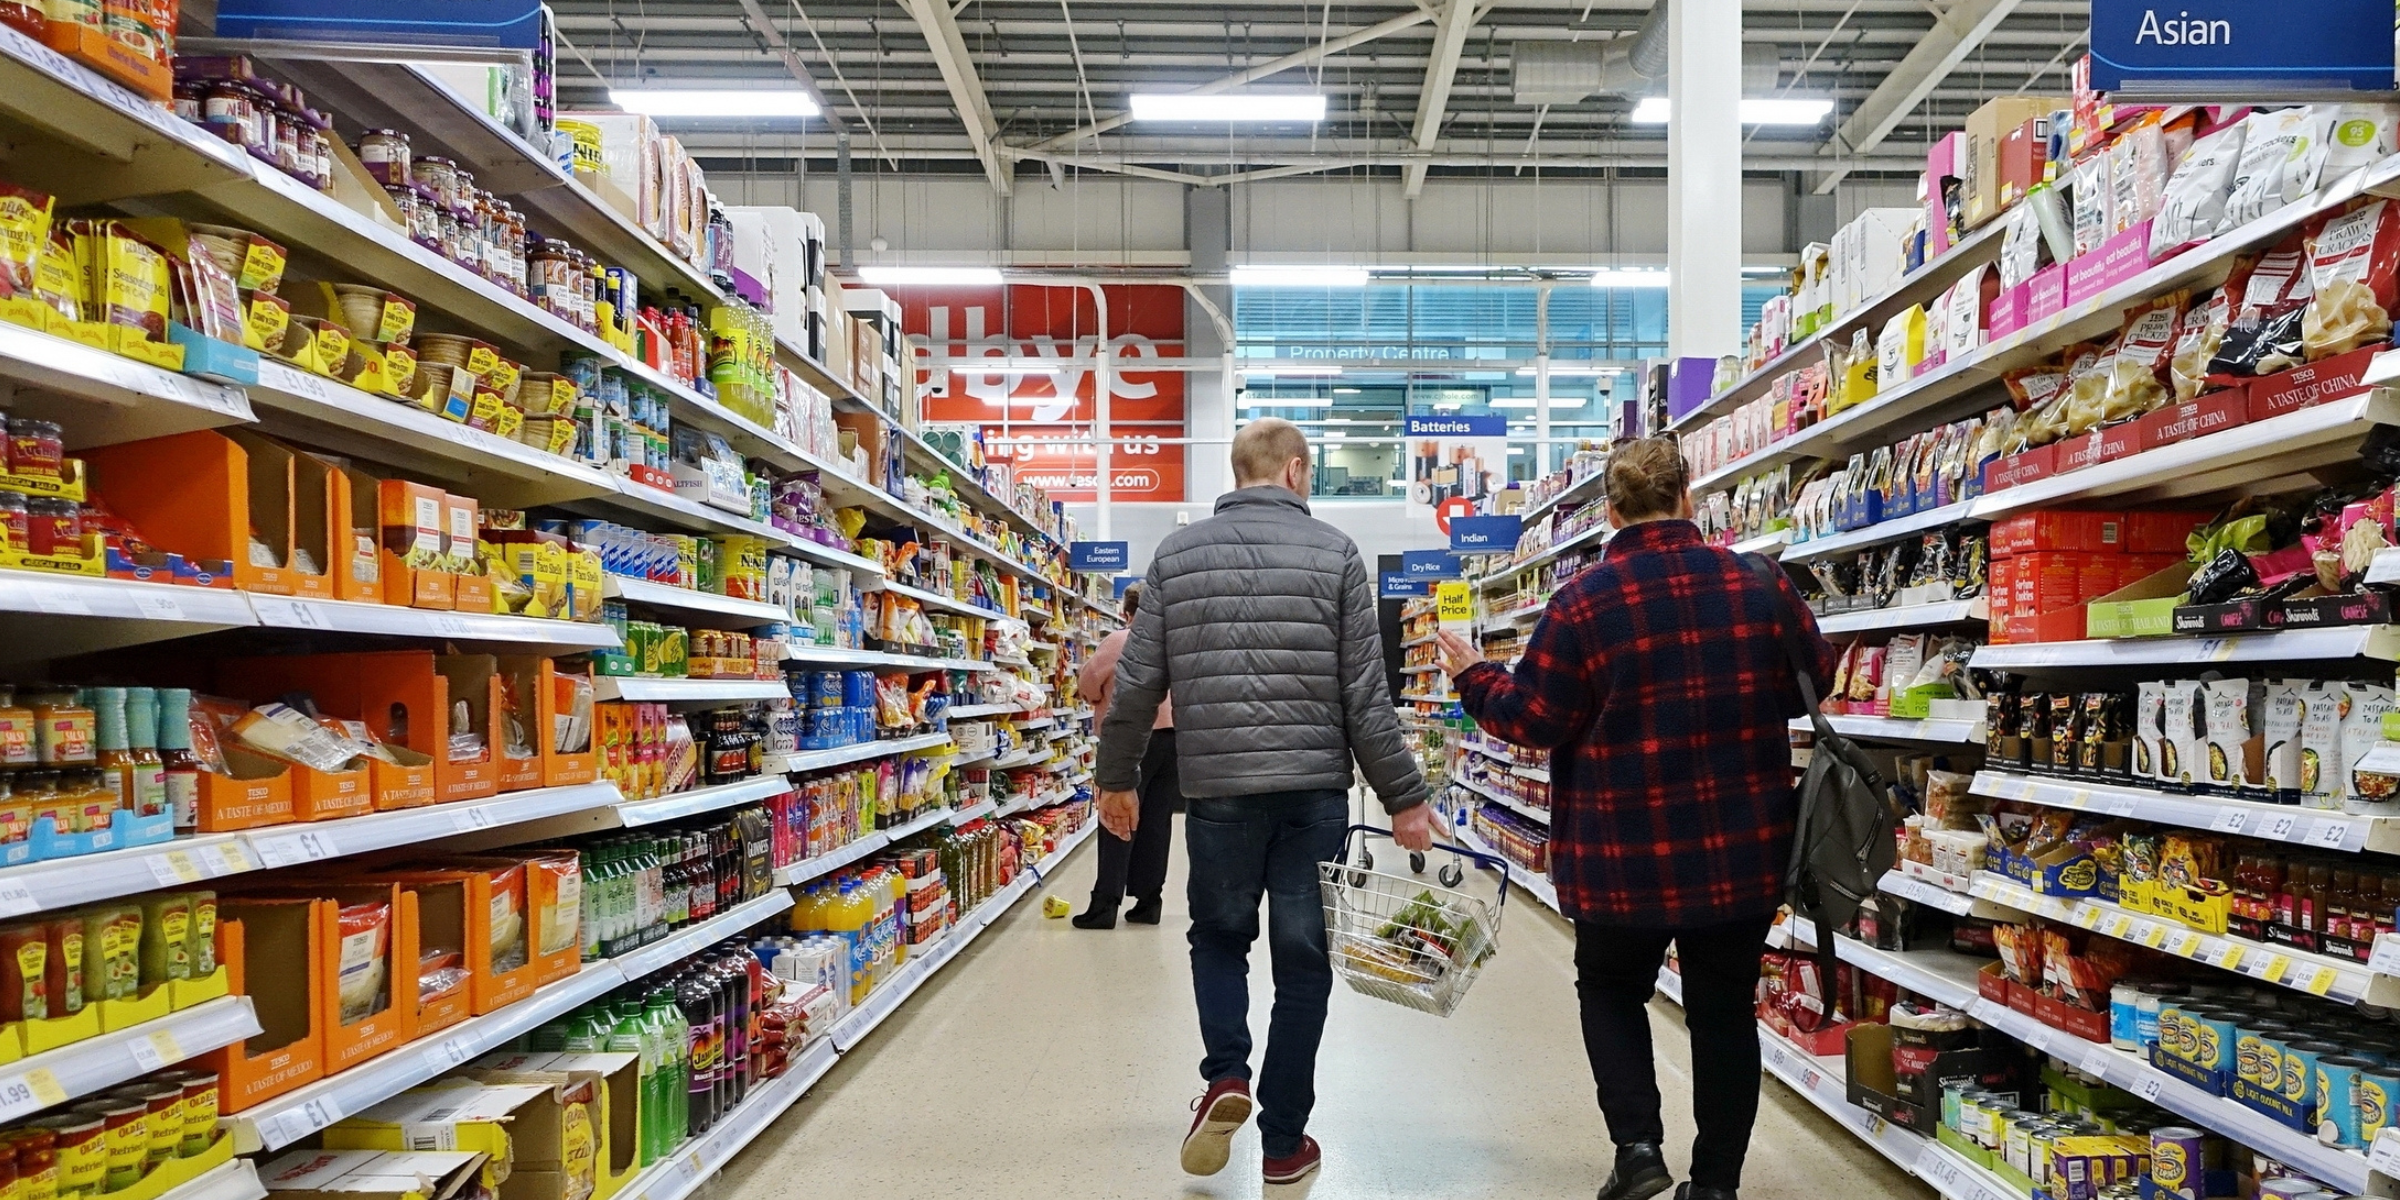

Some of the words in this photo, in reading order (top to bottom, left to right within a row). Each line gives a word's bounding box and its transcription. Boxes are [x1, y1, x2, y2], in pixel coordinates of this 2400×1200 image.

[2136, 10, 2231, 46] Asian
[2106, 251, 2116, 265] eat
[2117, 234, 2143, 262] beautiful
[2069, 271, 2079, 286] eat
[1290, 346, 1375, 362] Property
[1382, 346, 1450, 360] Centre
[2291, 368, 2315, 380] TESCO
[159, 376, 182, 396] £1
[284, 369, 326, 398] £1.99
[1412, 392, 1479, 401] www.cjhole.com
[2267, 396, 2276, 410] A
[2275, 388, 2306, 407] TASTE
[2306, 384, 2320, 399] OF
[2322, 373, 2358, 395] CHINA
[2180, 403, 2198, 414] TESCO
[1411, 421, 1471, 433] Batteries
[2157, 428, 2163, 440] A
[2164, 420, 2188, 438] TASTE
[2188, 418, 2199, 431] OF
[2199, 410, 2227, 429] CHINA
[1123, 434, 1161, 455] us
[2068, 453, 2074, 464] A
[2103, 440, 2126, 456] CHINA
[1994, 475, 1999, 485] A
[2021, 463, 2041, 477] CHINA
[1461, 533, 1488, 543] Indian
[1094, 546, 1119, 554] Eastern
[1086, 554, 1120, 564] European
[536, 562, 548, 574] Taco
[548, 563, 562, 576] Shells
[1412, 563, 1425, 572] Dry
[1425, 563, 1441, 571] Rice
[575, 569, 585, 580] Taco
[586, 569, 599, 583] Shells
[1991, 585, 2009, 596] Fortune
[2015, 578, 2034, 590] Fortune
[1443, 594, 1463, 604] Half
[2015, 590, 2034, 601] Cookies
[293, 602, 317, 627] £1
[1441, 605, 1467, 615] Price
[2091, 620, 2097, 631] A
[2129, 615, 2171, 631] THAILAND
[2363, 715, 2372, 723] TO
[5, 731, 26, 743] SALSA
[64, 730, 86, 742] SALSA
[247, 787, 268, 796] TESCO
[339, 780, 356, 790] TESCO
[382, 790, 388, 801] A
[217, 808, 225, 820] A
[226, 804, 251, 819] TASTE
[252, 804, 262, 816] OF
[263, 801, 292, 816] MEXICO
[314, 800, 321, 812] A
[322, 798, 344, 810] TASTE
[2228, 812, 2246, 829] £2
[2273, 819, 2292, 835] £2
[2324, 825, 2345, 842] £2
[299, 833, 326, 857] £1
[747, 838, 769, 858] GUINNESS
[360, 1024, 375, 1035] TESCO
[341, 1049, 346, 1060] A
[347, 1043, 365, 1058] TASTE
[365, 1040, 371, 1052] OF
[371, 1030, 394, 1049] MEXICO
[444, 1038, 466, 1063] £1
[270, 1053, 290, 1068] TESCO
[244, 1083, 251, 1096] A
[252, 1074, 275, 1093] TASTE
[275, 1069, 285, 1083] OF
[286, 1059, 313, 1079] MEXICO
[2144, 1079, 2160, 1096] £2
[190, 1096, 206, 1108] OLD
[2246, 1087, 2259, 1102] LIGHT
[2259, 1092, 2283, 1113] COCONUT
[2281, 1104, 2294, 1118] MILK
[303, 1099, 331, 1128] £1
[118, 1123, 136, 1138] OLD
[1866, 1113, 1878, 1133] £2
[1932, 1160, 1958, 1185] £1.45
